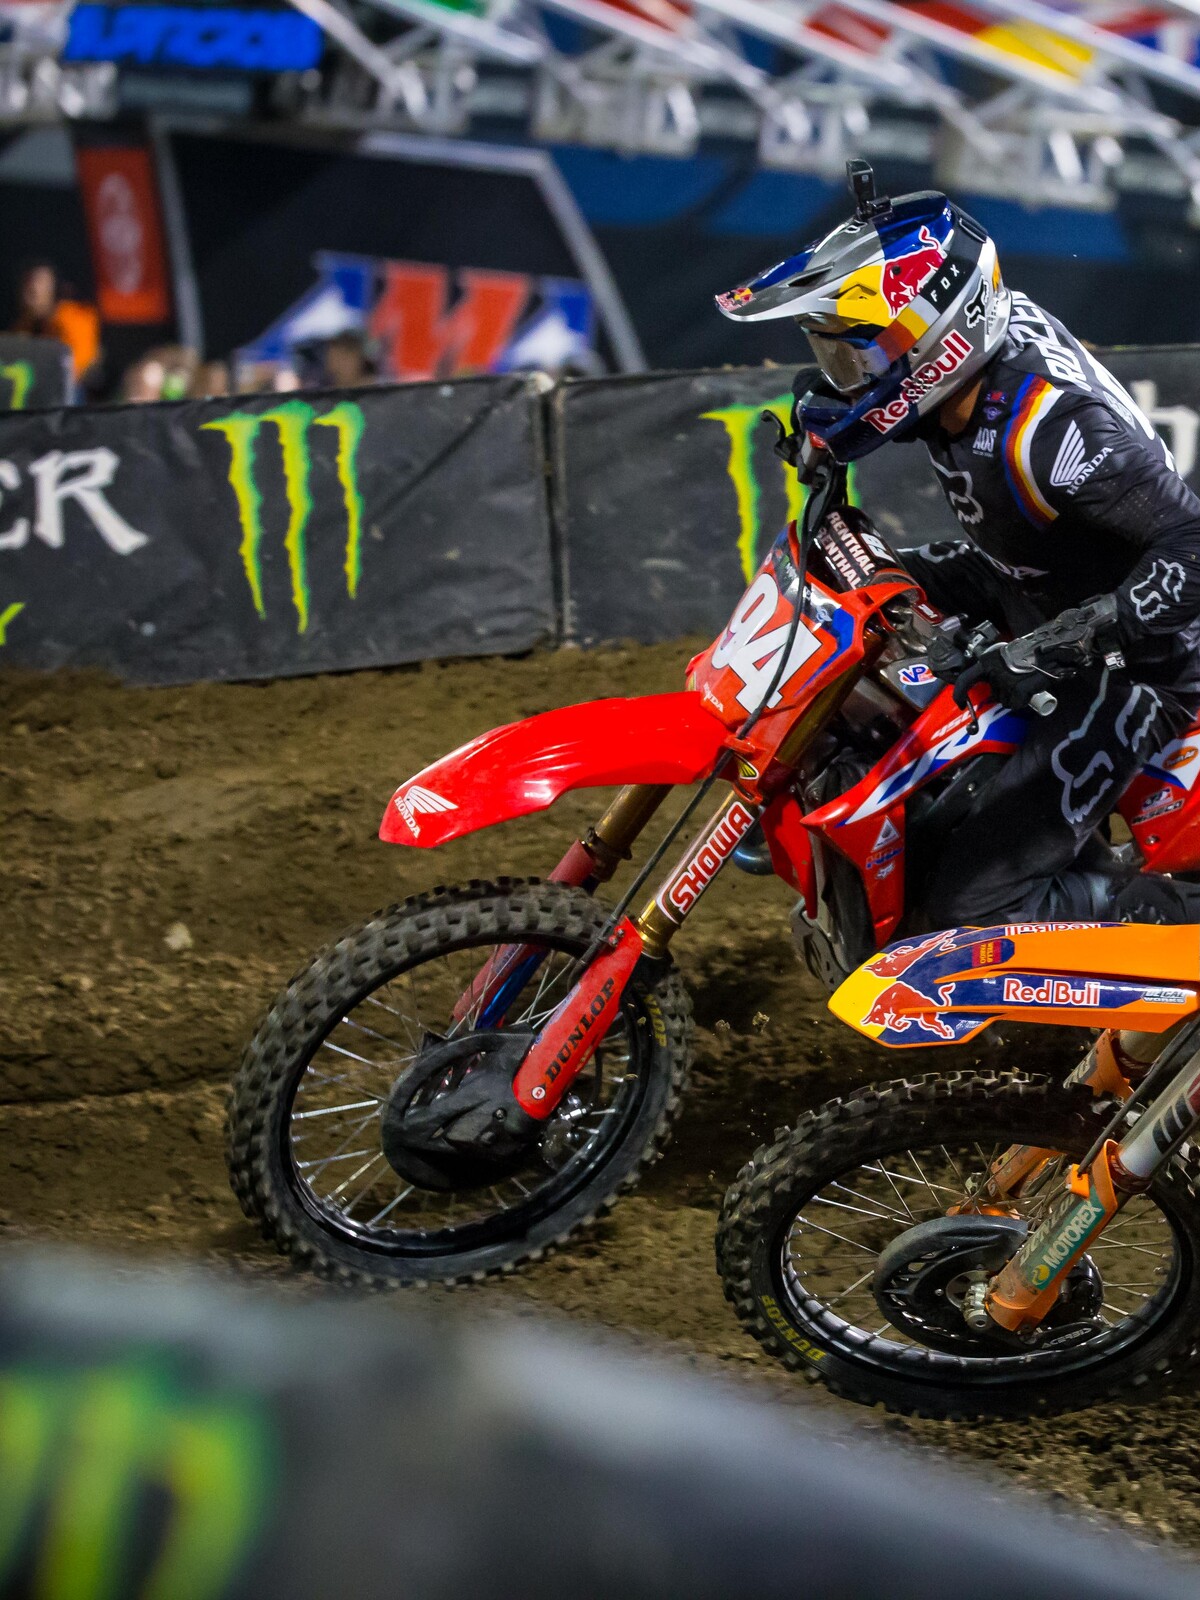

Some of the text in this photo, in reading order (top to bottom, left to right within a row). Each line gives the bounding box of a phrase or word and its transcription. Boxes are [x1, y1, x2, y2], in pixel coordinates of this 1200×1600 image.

[931, 264, 960, 302] FOX
[1066, 446, 1114, 496] HONDA
[827, 511, 876, 576] RENTHAL
[711, 572, 823, 716] 94
[395, 796, 422, 839] HONDA
[669, 802, 755, 914] SHOWA
[545, 977, 615, 1084] DUNLOP
[1042, 1199, 1102, 1269] MOTOREX
[760, 1294, 828, 1361] DUNLOP
